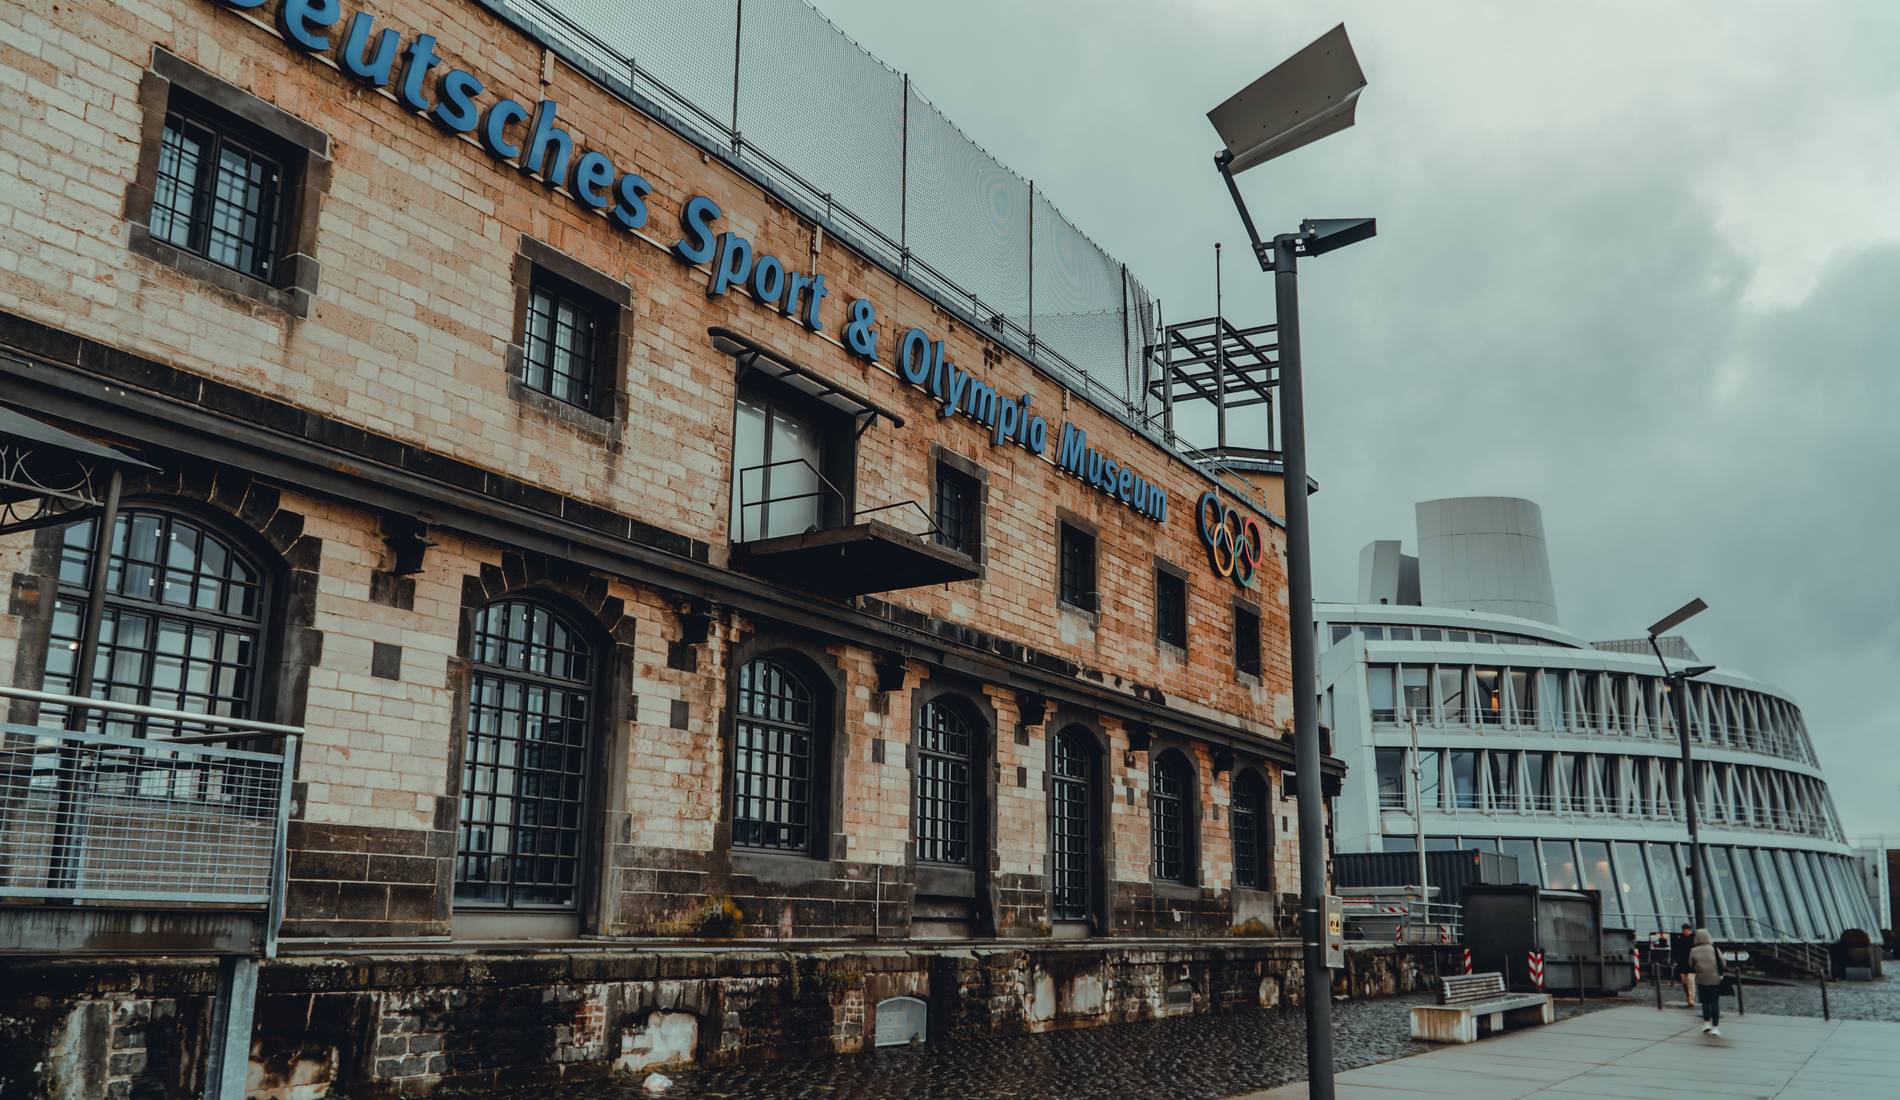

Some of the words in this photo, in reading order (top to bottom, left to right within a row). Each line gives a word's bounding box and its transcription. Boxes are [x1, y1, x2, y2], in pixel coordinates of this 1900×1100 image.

[220, 0, 653, 230] eutsches
[673, 196, 829, 331] Sport
[844, 299, 879, 362] &
[900, 329, 1048, 454] Olympia
[1060, 423, 1168, 521] Museum
